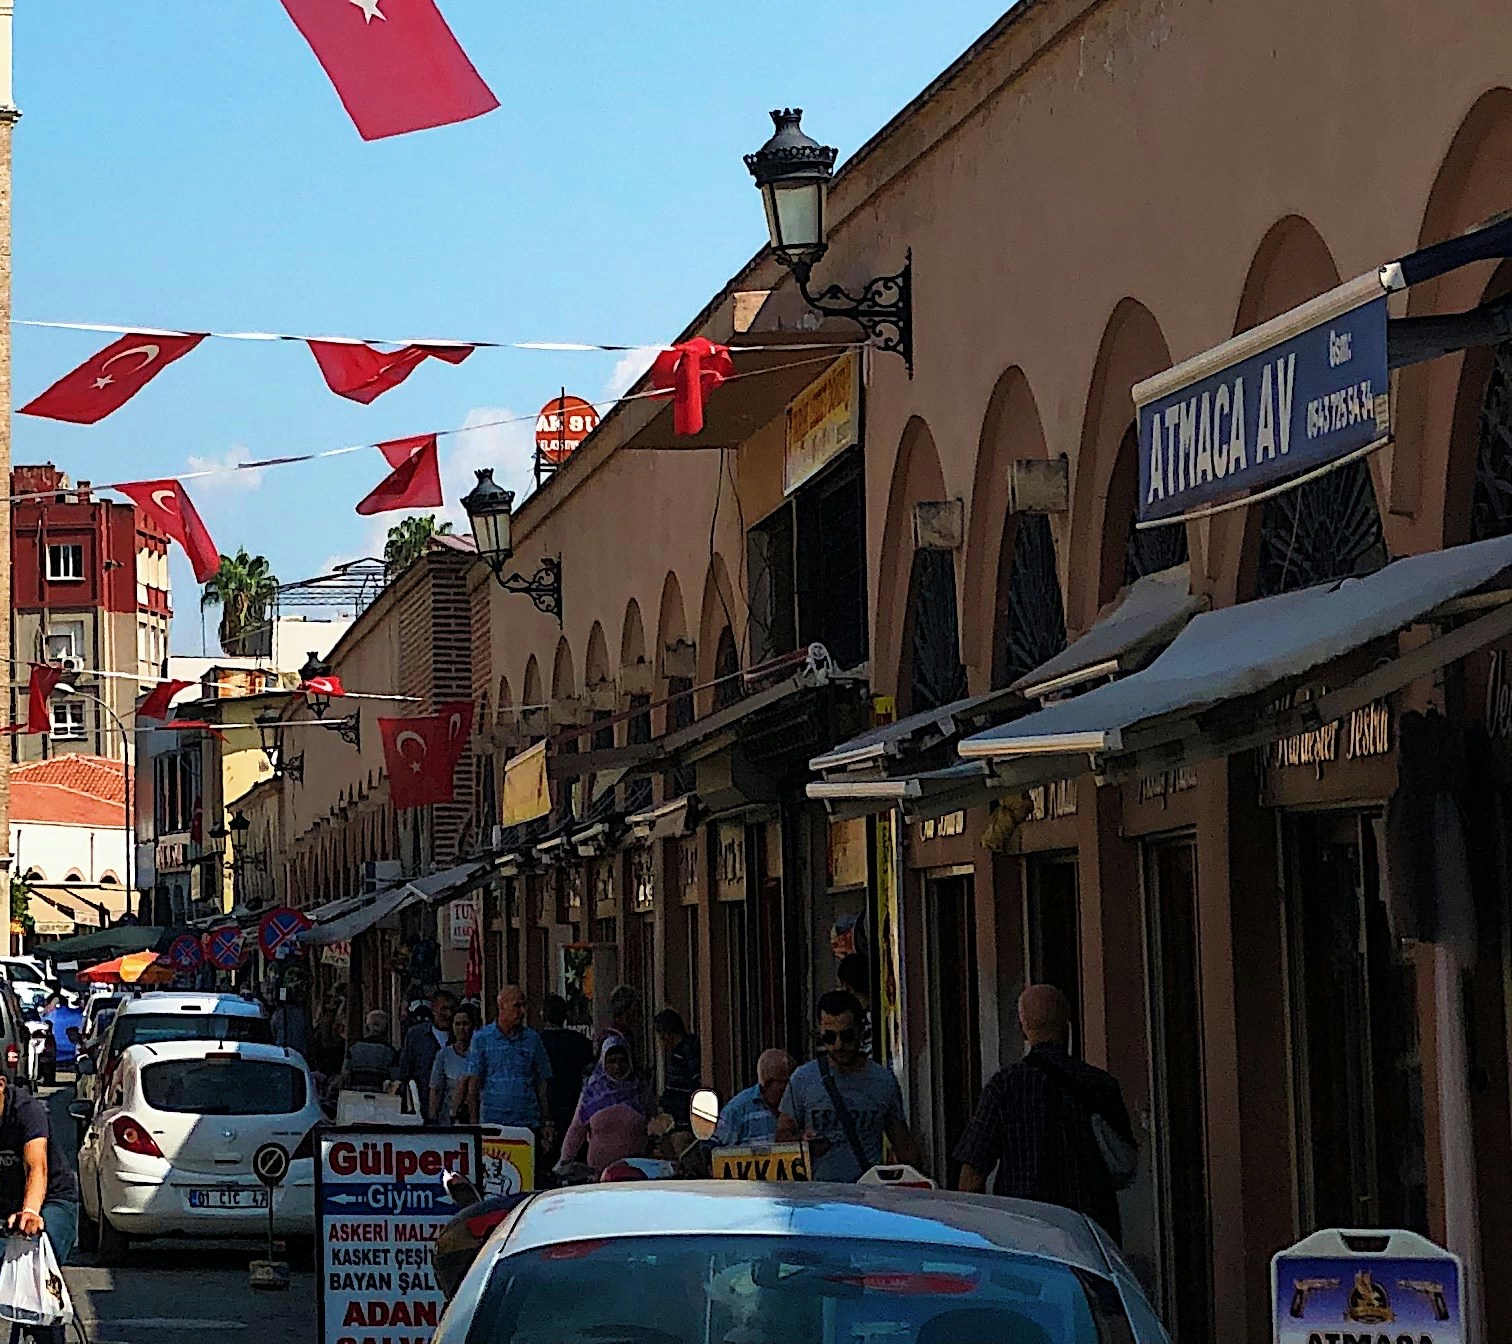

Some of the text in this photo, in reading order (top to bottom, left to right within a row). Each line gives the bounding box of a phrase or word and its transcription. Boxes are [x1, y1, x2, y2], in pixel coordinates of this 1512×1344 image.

[1147, 353, 1296, 504] ATMACA AV
[328, 1141, 470, 1183] Gülperi
[367, 1184, 434, 1215] Giyim
[329, 1219, 389, 1242] ASKERİ
[331, 1248, 391, 1266] KASKET
[329, 1272, 392, 1291] BAYAN
